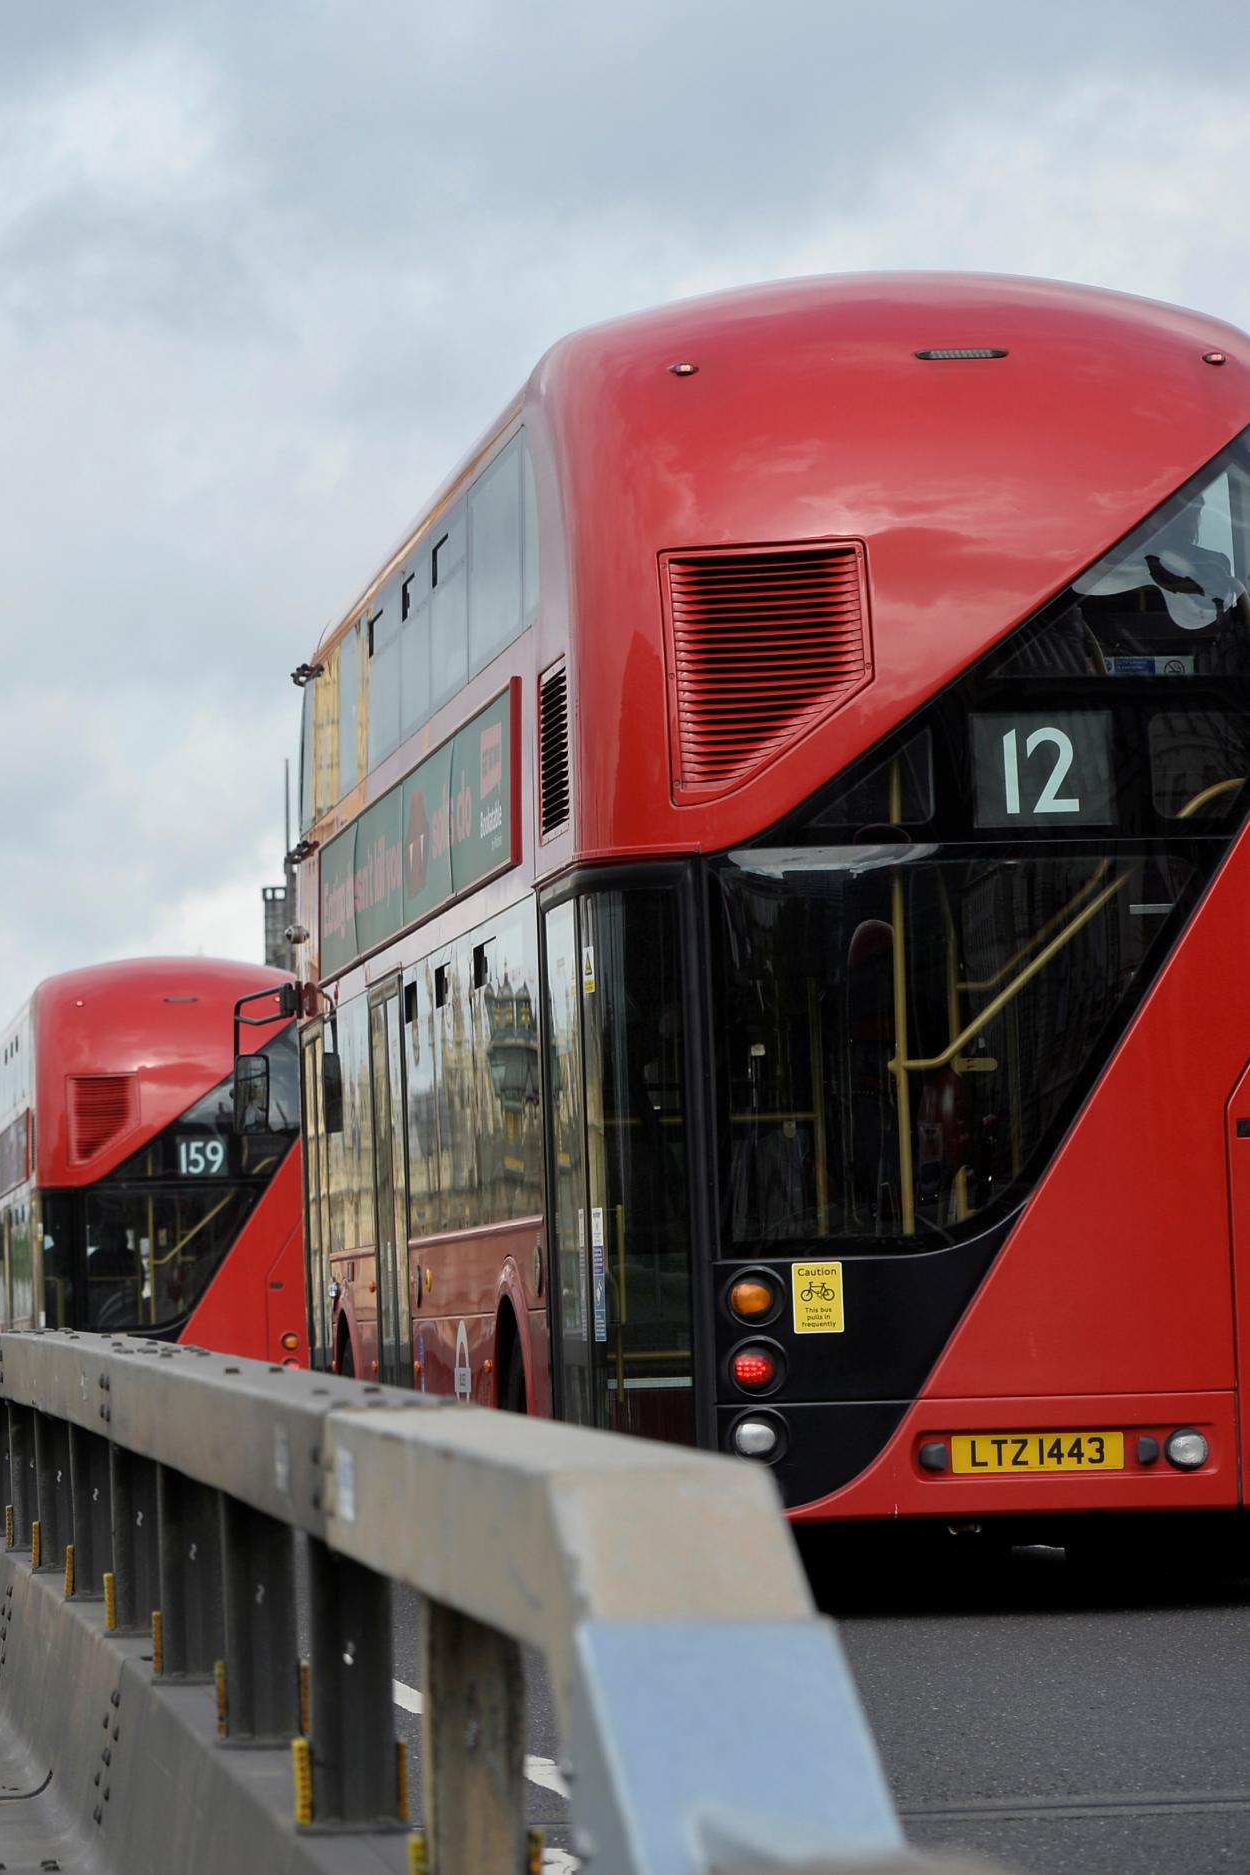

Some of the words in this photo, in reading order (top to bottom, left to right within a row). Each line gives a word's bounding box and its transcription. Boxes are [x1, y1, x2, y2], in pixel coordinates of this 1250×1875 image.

[1002, 727, 1080, 814] 12
[180, 1140, 224, 1175] 159
[797, 1267, 837, 1277] Caution
[970, 1438, 1029, 1467] LTZ
[1038, 1437, 1105, 1466] 1443
